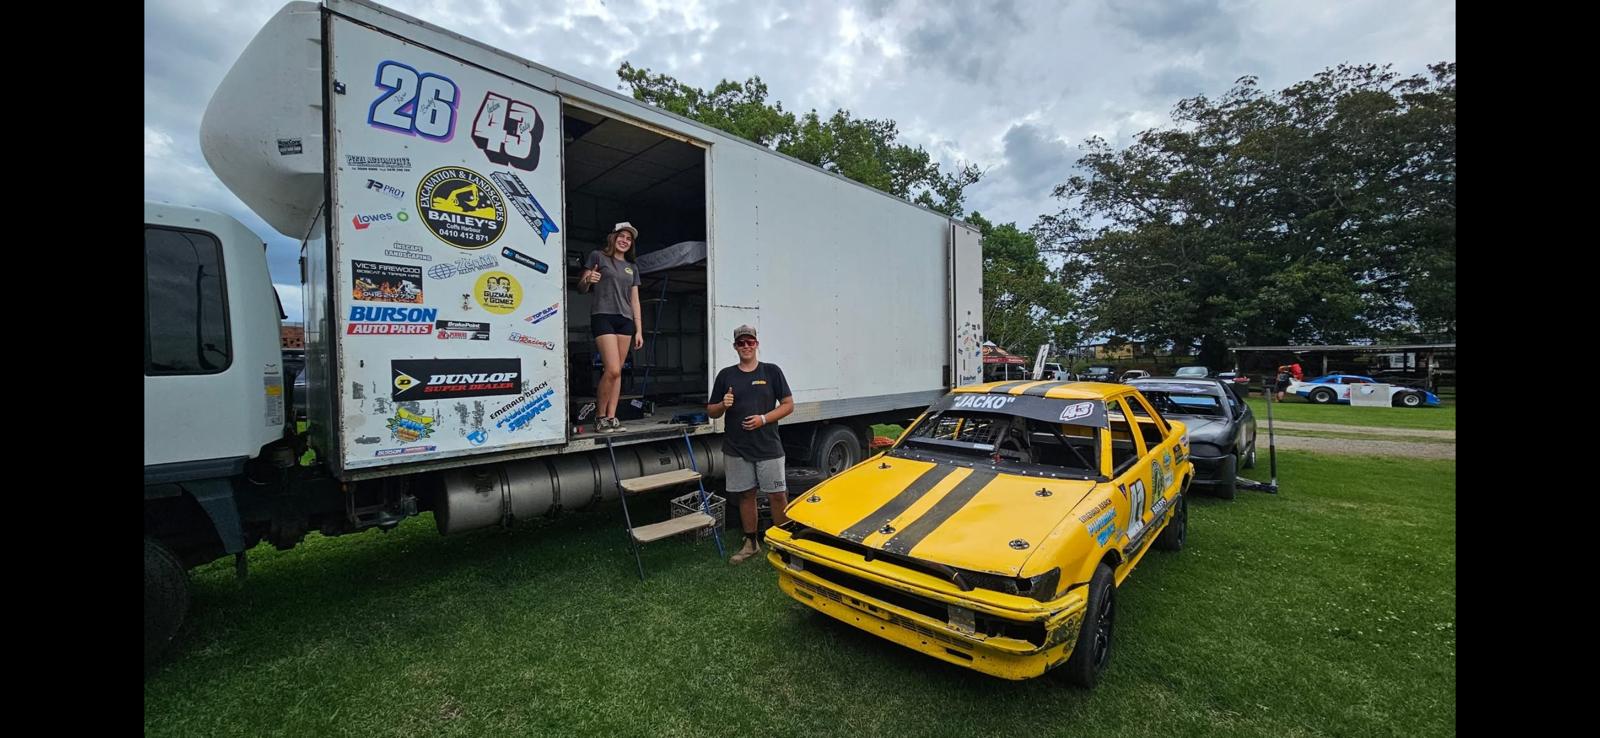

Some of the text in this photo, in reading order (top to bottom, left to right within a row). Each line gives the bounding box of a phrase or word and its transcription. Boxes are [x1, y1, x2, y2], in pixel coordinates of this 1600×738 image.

[367, 59, 461, 143] 26
[471, 91, 544, 171] 43
[420, 170, 457, 208] EXCAVATION
[458, 170, 467, 179] &
[468, 172, 504, 222] LANDSCAPES
[358, 212, 393, 223] lowes
[428, 210, 498, 230] BAILEY'S
[439, 228, 490, 242] 0410 412 871
[378, 264, 421, 274] FIREWOOD
[349, 306, 438, 322] BURSON
[352, 324, 429, 334] AUTO PARTS
[427, 372, 518, 386] DUNLOP
[424, 382, 514, 393] SUPER DEALER
[489, 381, 549, 420] EMERALD BEACH
